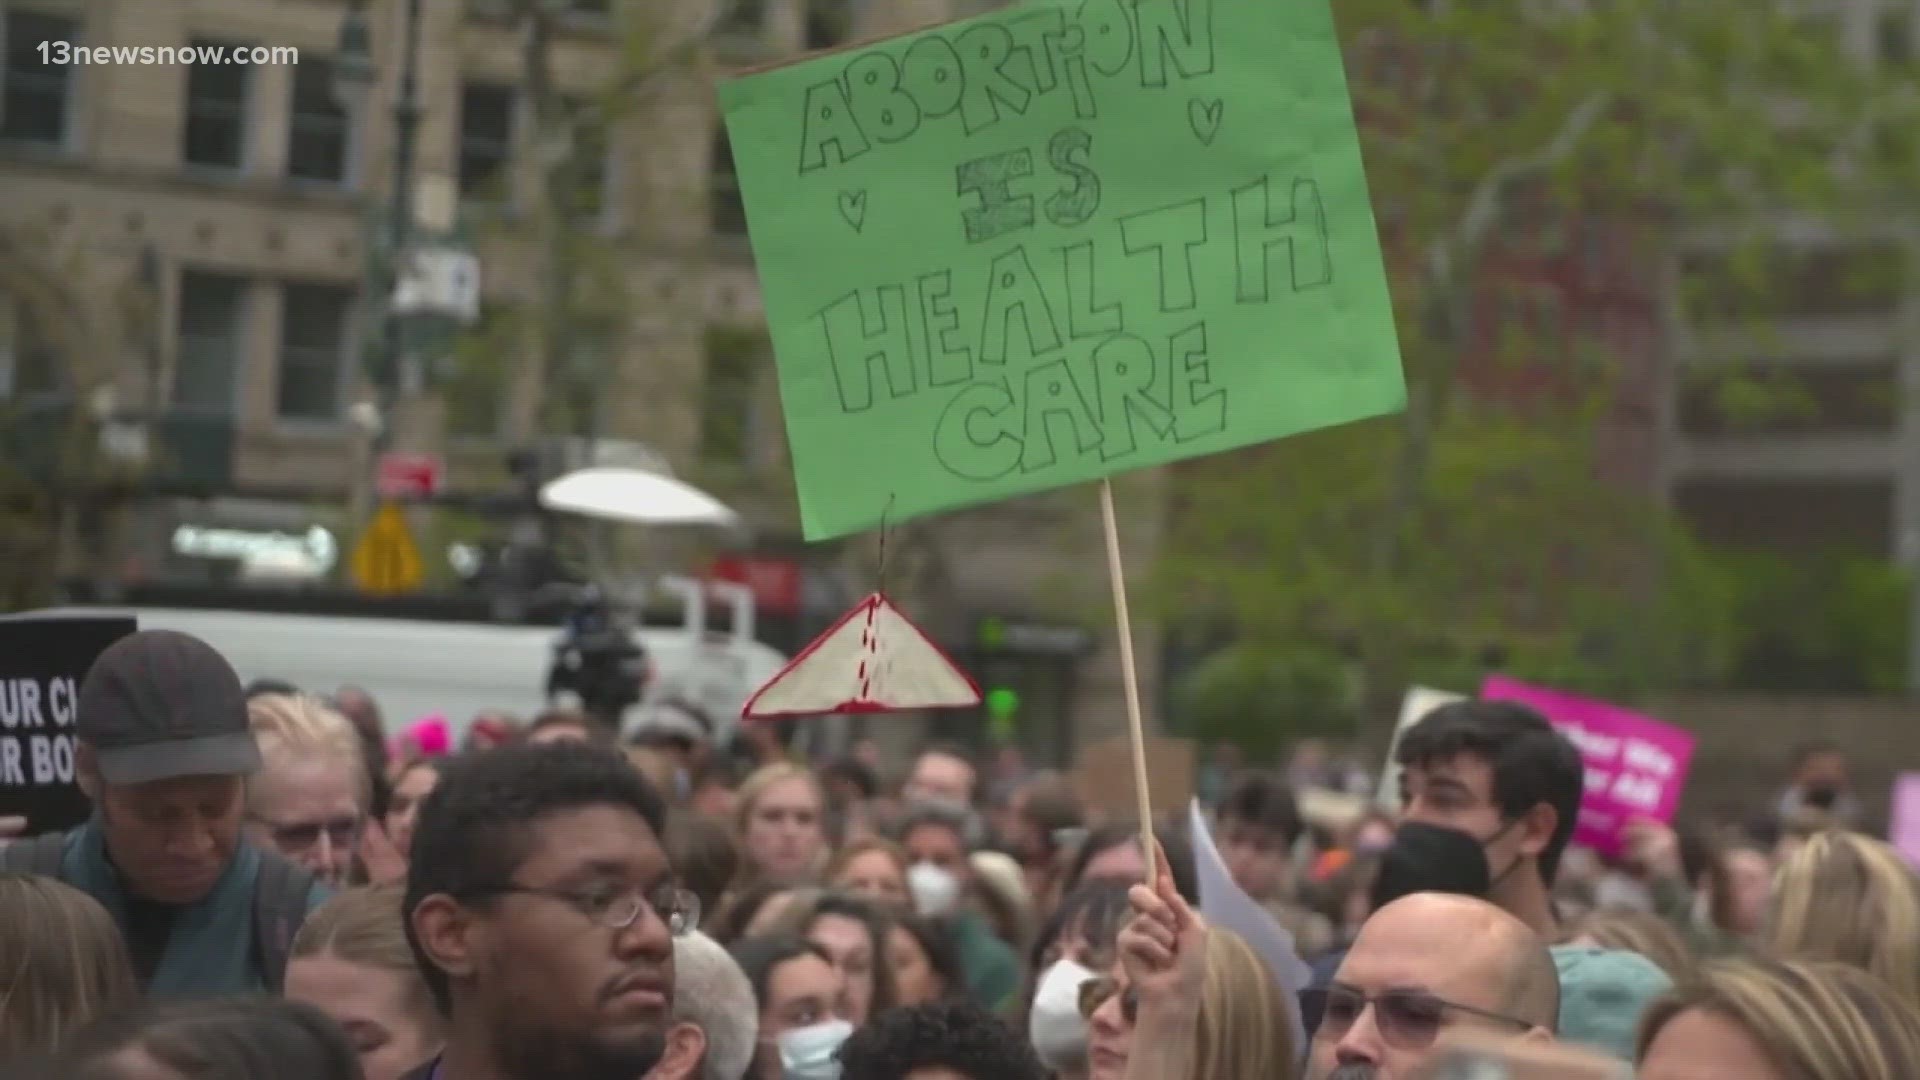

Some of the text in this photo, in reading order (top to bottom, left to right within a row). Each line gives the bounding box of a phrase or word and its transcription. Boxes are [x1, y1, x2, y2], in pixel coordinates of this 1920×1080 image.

[955, 127, 1100, 244] IS
[808, 175, 1331, 414] HEALTH
[933, 321, 1227, 480] CARE
[0, 733, 79, 784] R BO
